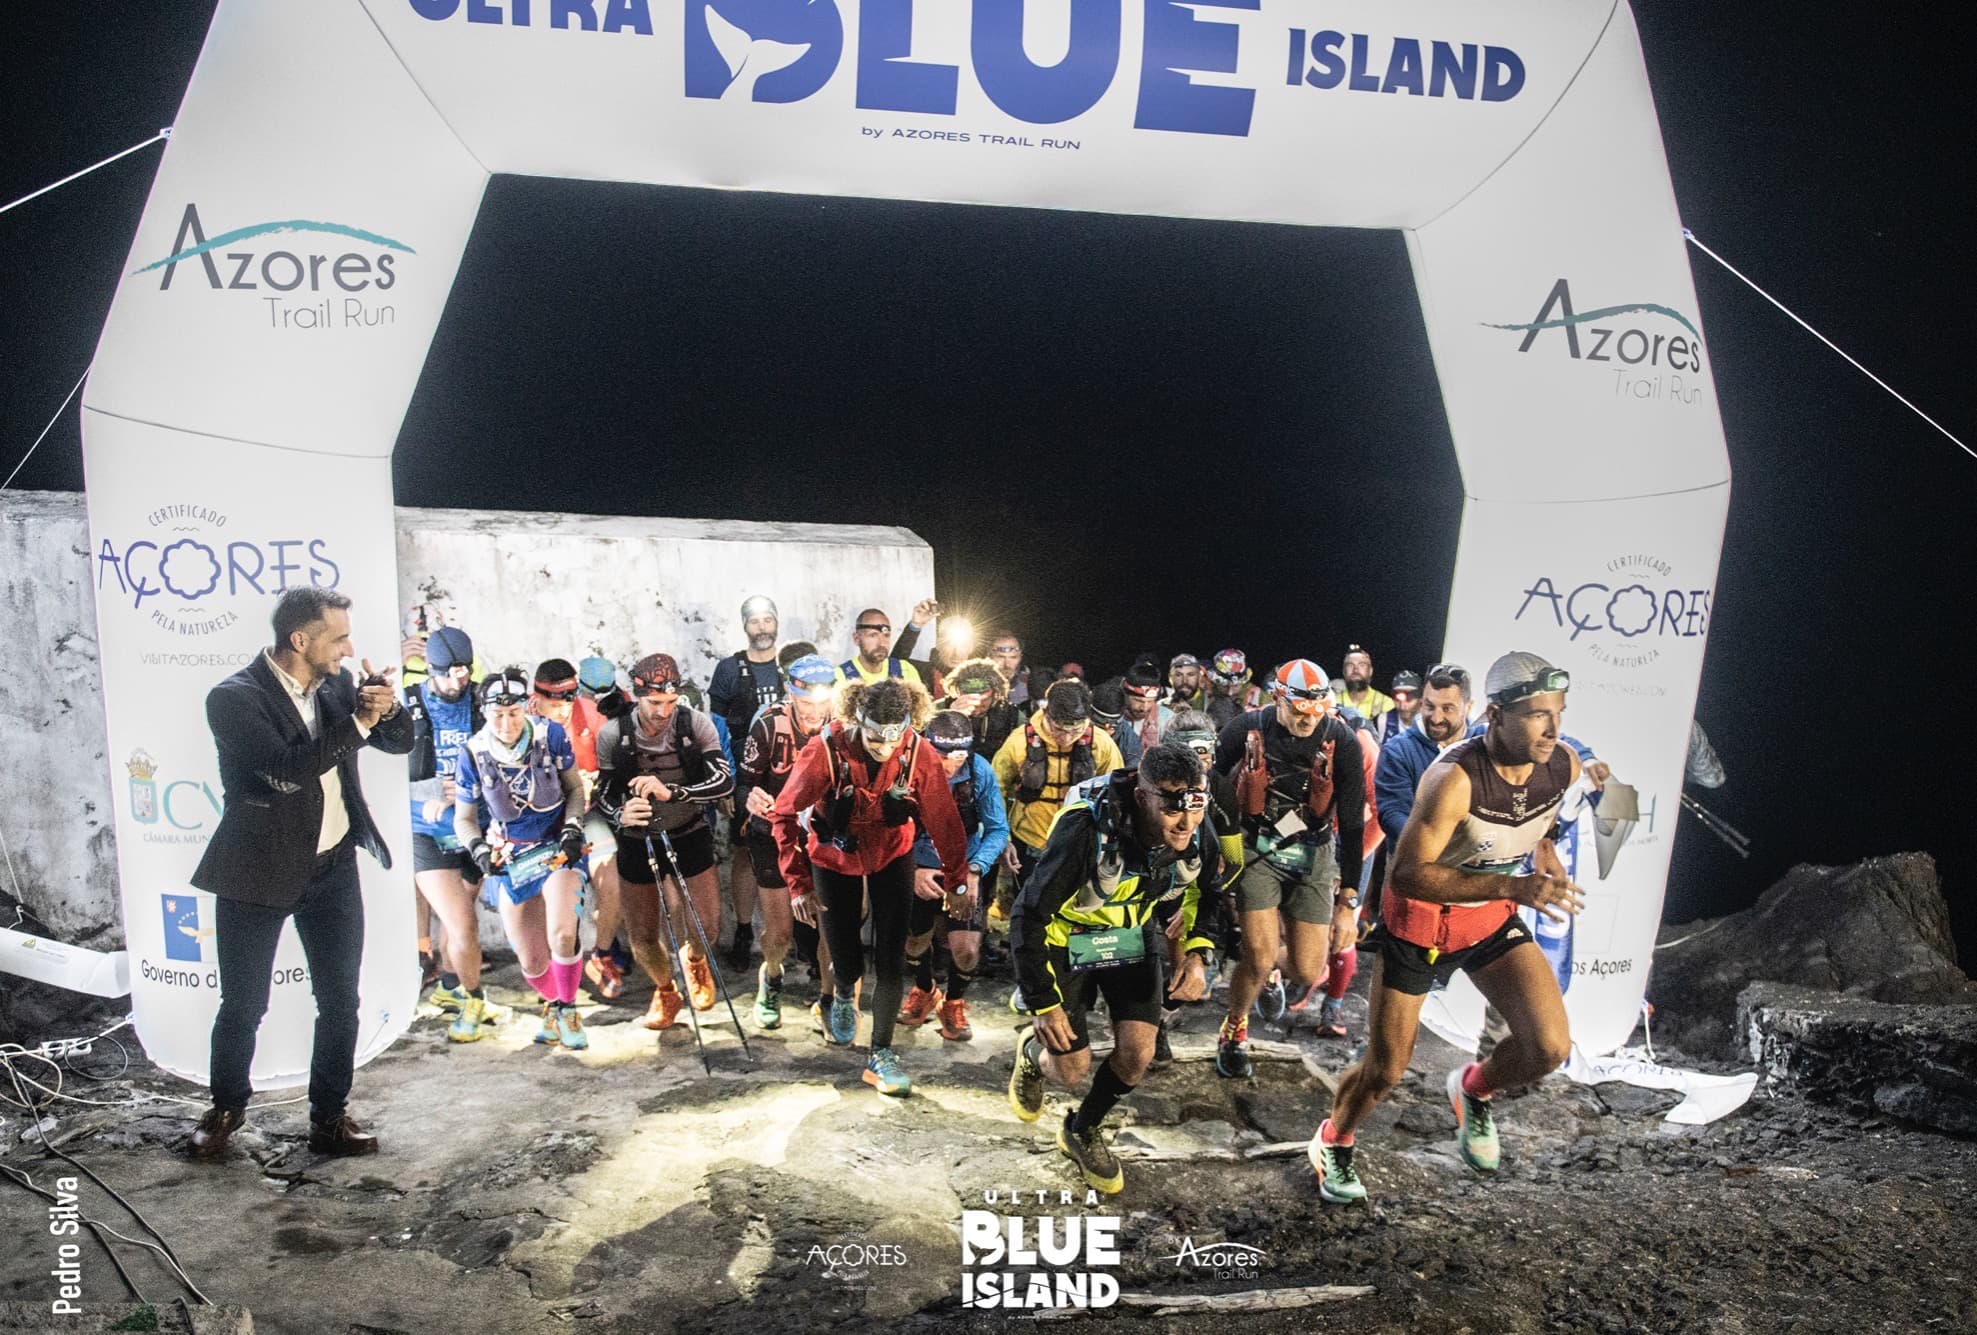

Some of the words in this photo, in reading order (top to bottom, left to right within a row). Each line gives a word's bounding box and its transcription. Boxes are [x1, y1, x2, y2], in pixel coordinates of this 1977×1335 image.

[1286, 28, 1526, 102] ISLAND
[862, 126, 883, 139] by
[892, 128, 970, 142] AZORES
[979, 134, 1034, 147] TRAIL
[1041, 139, 1080, 150] RUN
[160, 203, 395, 292] Azores
[263, 297, 331, 329] Trail
[344, 298, 395, 327] Run
[1518, 278, 1700, 373] Azores
[1612, 368, 1662, 399] Trail
[1669, 374, 1702, 406] Run
[148, 504, 227, 528] CERTIFICADO
[98, 538, 340, 609] AÇORES
[1607, 554, 1672, 577] CERTIFICADO
[151, 609, 175, 632] PELA
[179, 611, 239, 636] NATUREZA
[141, 959, 200, 988] Governo
[1590, 959, 1632, 981] Açores
